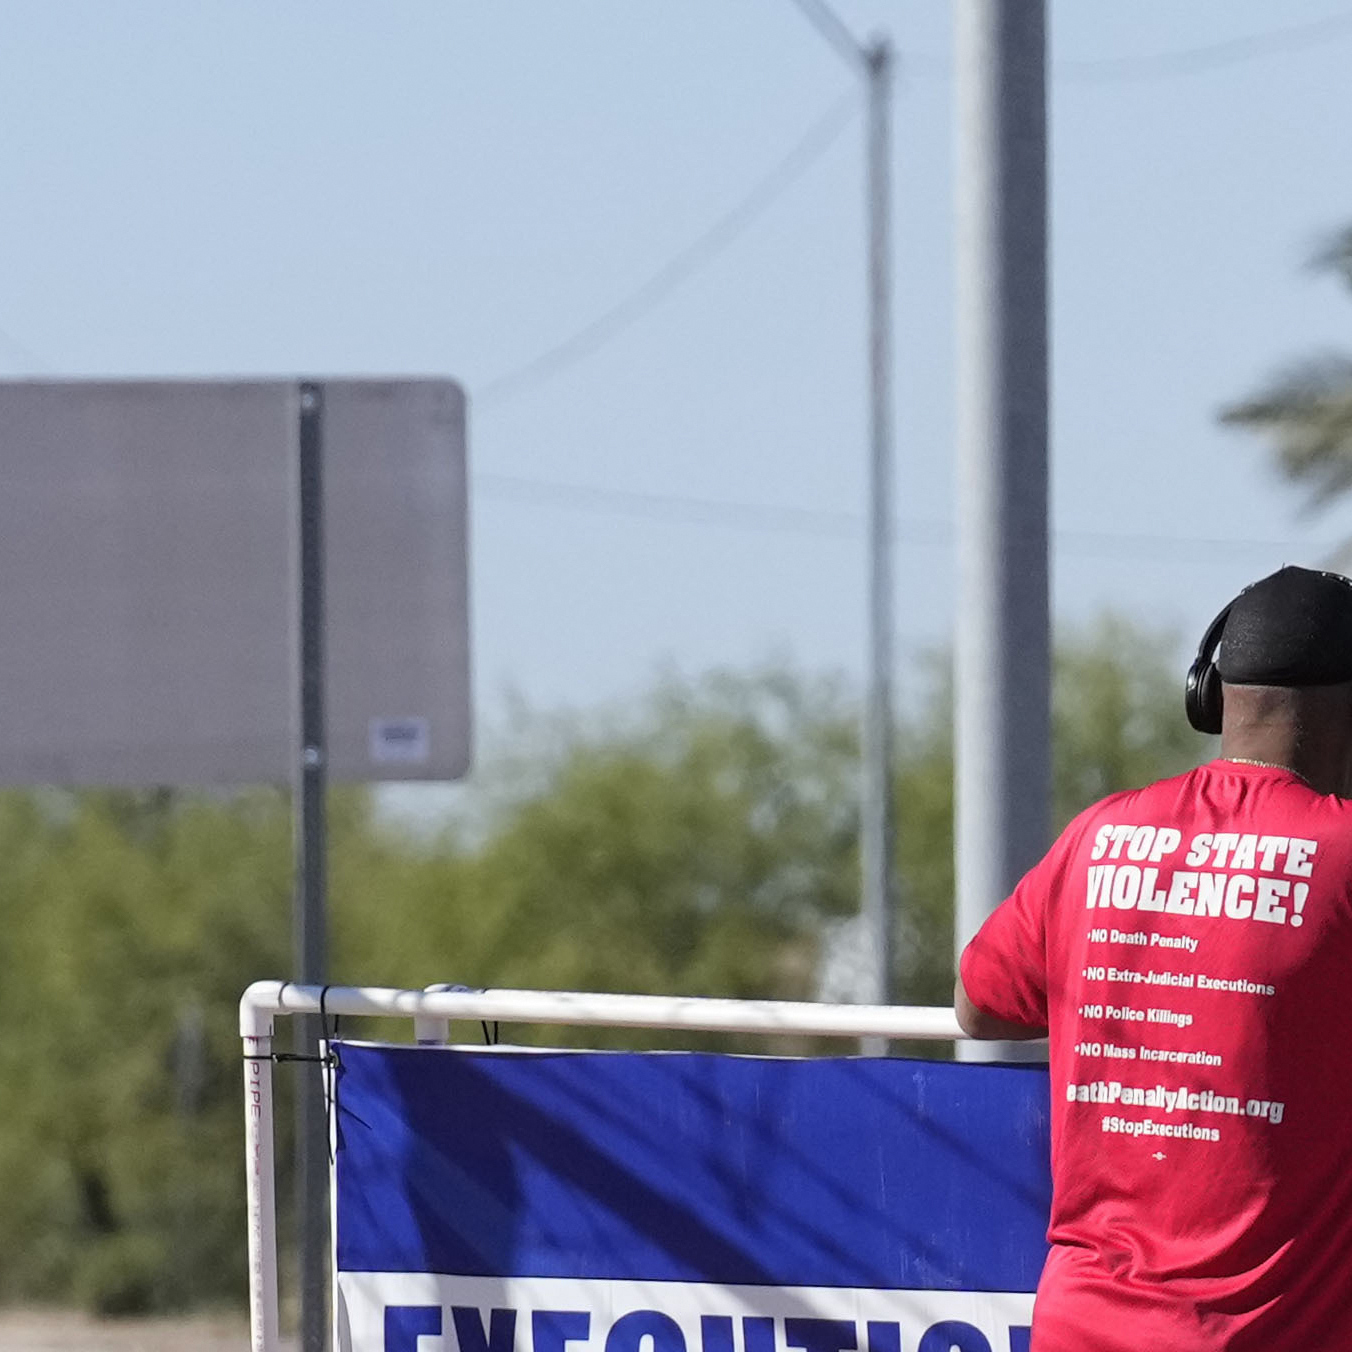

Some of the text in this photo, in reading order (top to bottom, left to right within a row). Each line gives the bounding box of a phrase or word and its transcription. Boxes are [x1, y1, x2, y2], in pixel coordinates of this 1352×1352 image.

[1092, 823, 1317, 877] STOP STATE
[1086, 865, 1310, 926] VIOLENCE!
[1110, 930, 1147, 946] Death
[1150, 932, 1198, 952] Penalty
[1107, 968, 1194, 988] Extra-Judicial
[1197, 975, 1276, 996] Executions
[1105, 1006, 1144, 1022] Police
[1147, 1009, 1193, 1027] Killings
[1104, 1044, 1136, 1060] Mass
[1139, 1046, 1222, 1066] Incarceration
[1066, 1081, 1284, 1124] eathPenaltyAction.org
[1102, 1116, 1221, 1142] #StopExecutions
